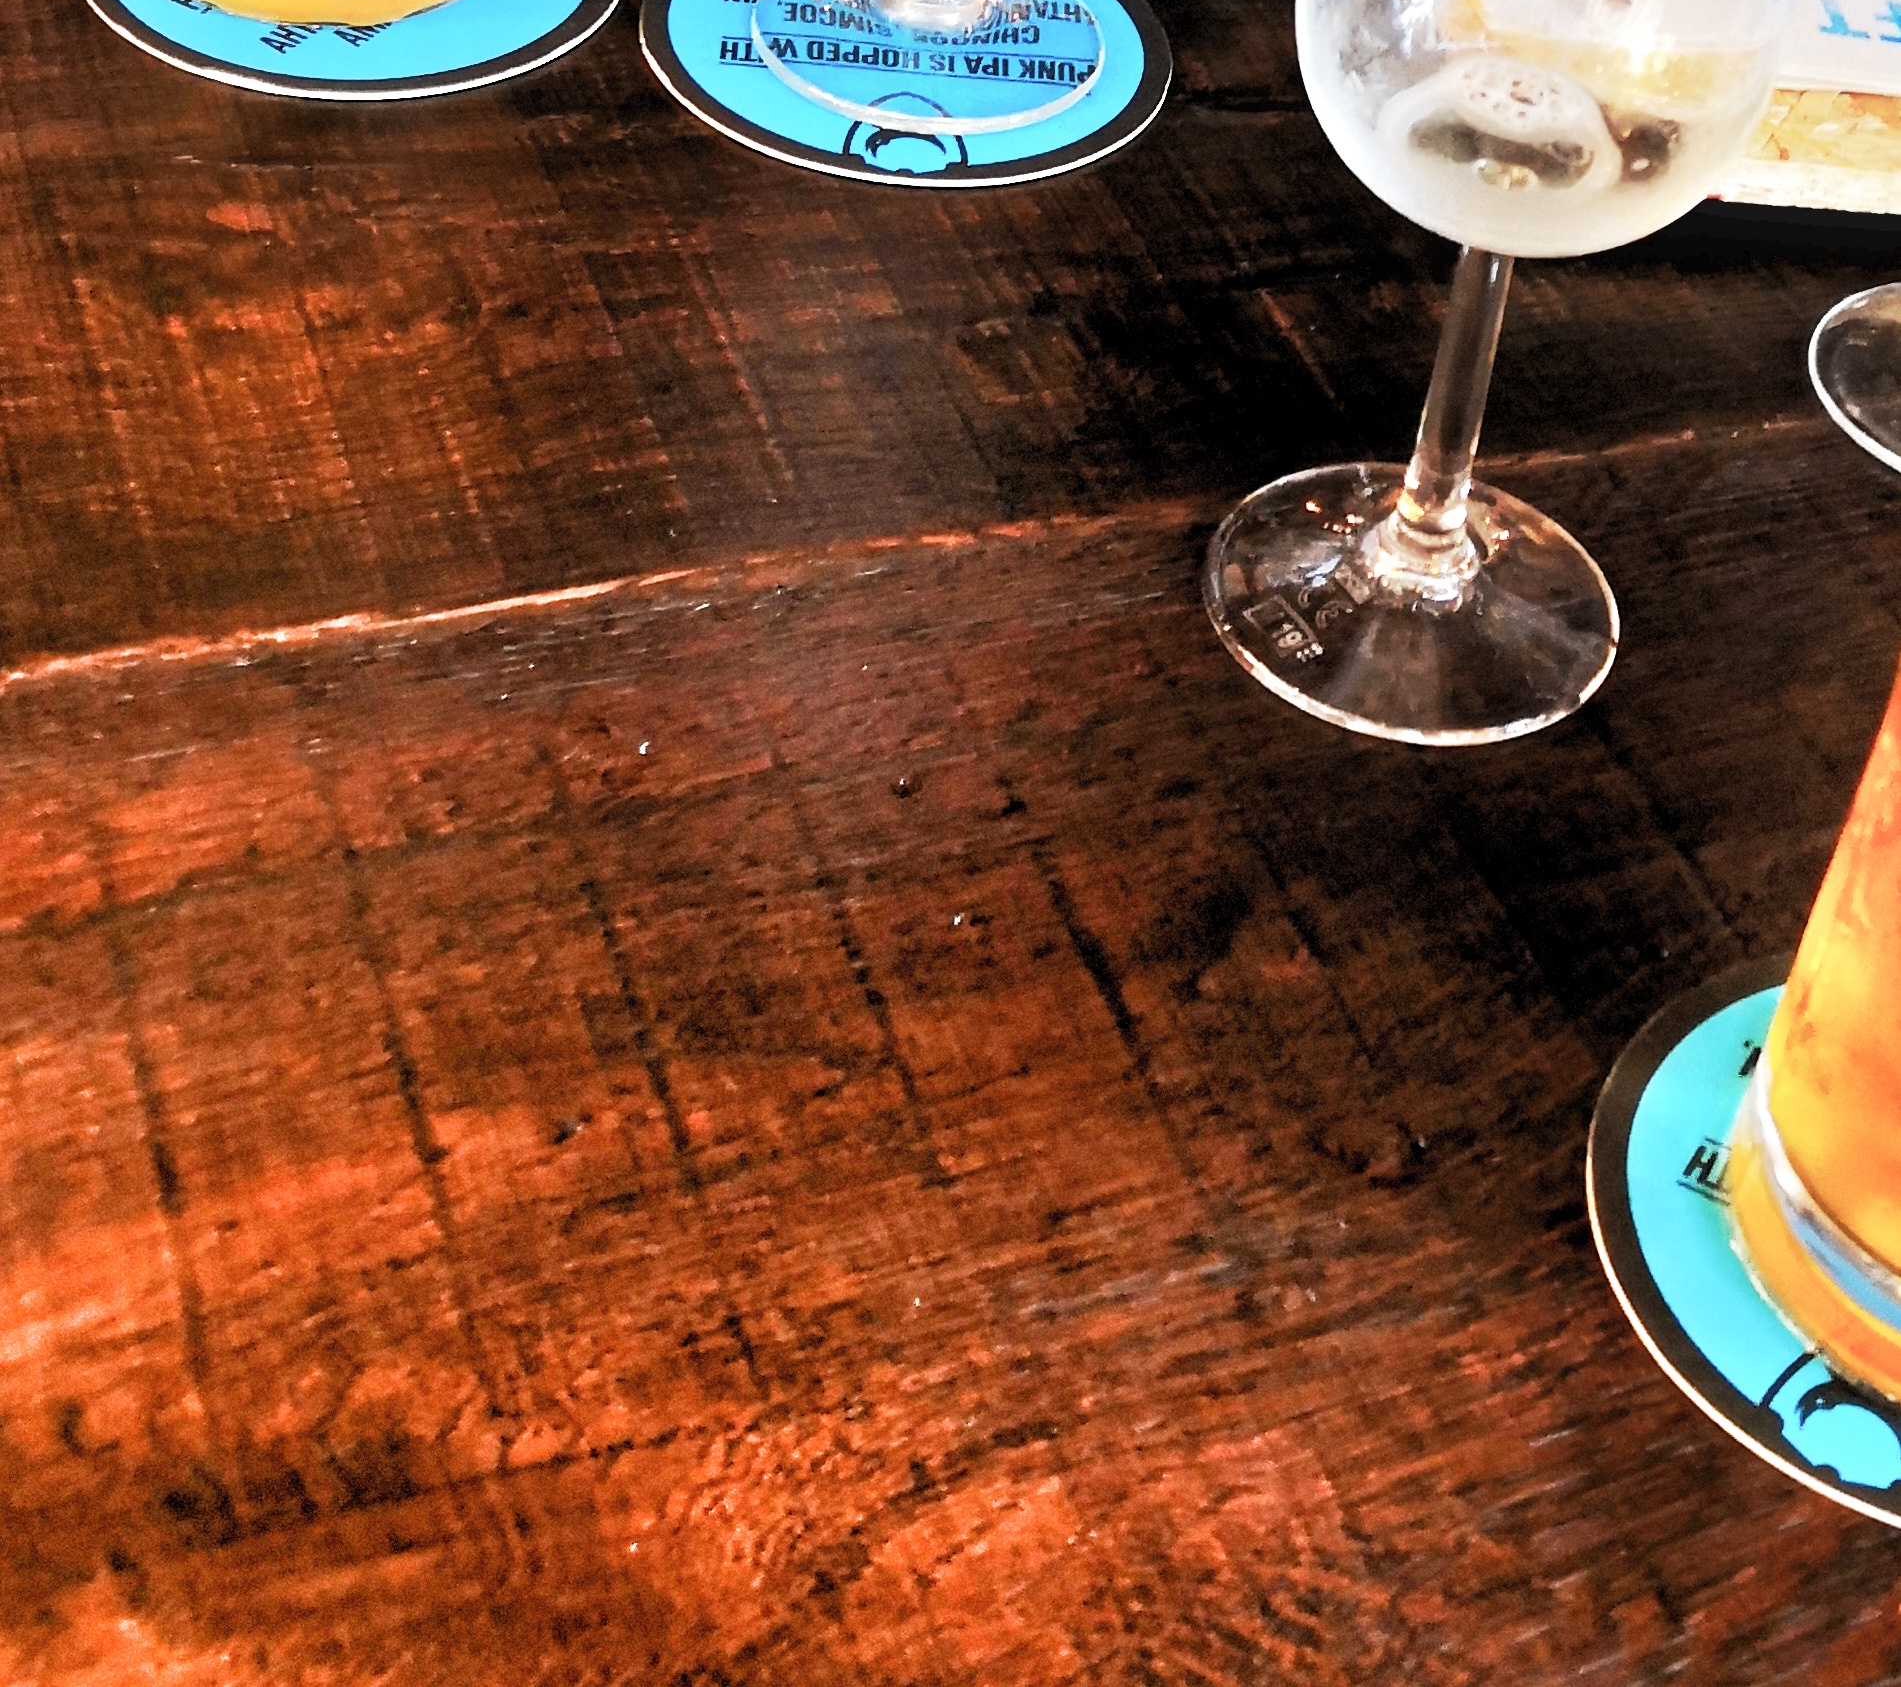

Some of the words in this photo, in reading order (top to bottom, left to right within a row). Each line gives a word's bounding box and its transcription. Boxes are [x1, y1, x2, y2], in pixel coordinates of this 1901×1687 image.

[719, 36, 799, 64] WTH
[806, 39, 921, 71] HOPPED
[929, 52, 955, 73] IS
[964, 55, 1010, 78] IPA
[1018, 60, 1097, 84] PUNK
